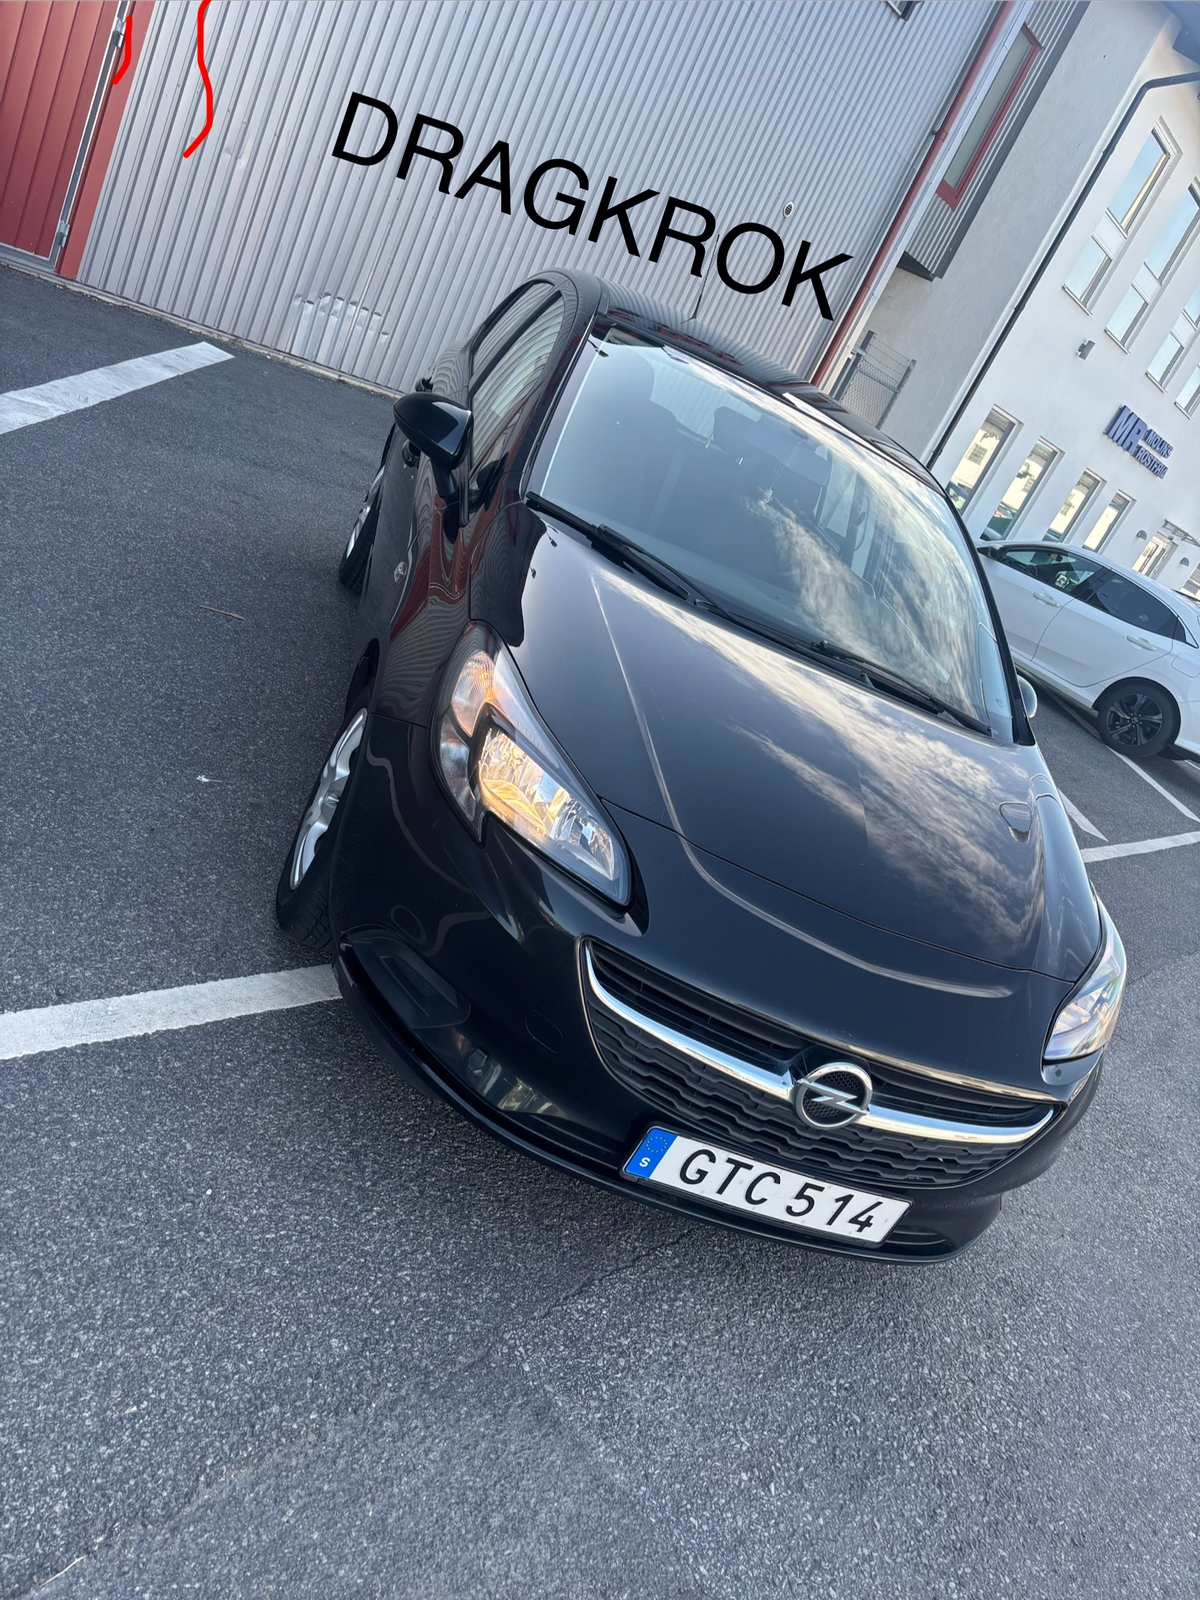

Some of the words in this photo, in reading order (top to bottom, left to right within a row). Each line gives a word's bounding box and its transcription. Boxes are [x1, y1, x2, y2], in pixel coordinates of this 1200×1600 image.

[1104, 405, 1148, 454] MR
[1143, 428, 1173, 459] MOLINS
[638, 1156, 650, 1167] S
[680, 1149, 781, 1205] GTC
[785, 1183, 883, 1233] 514
